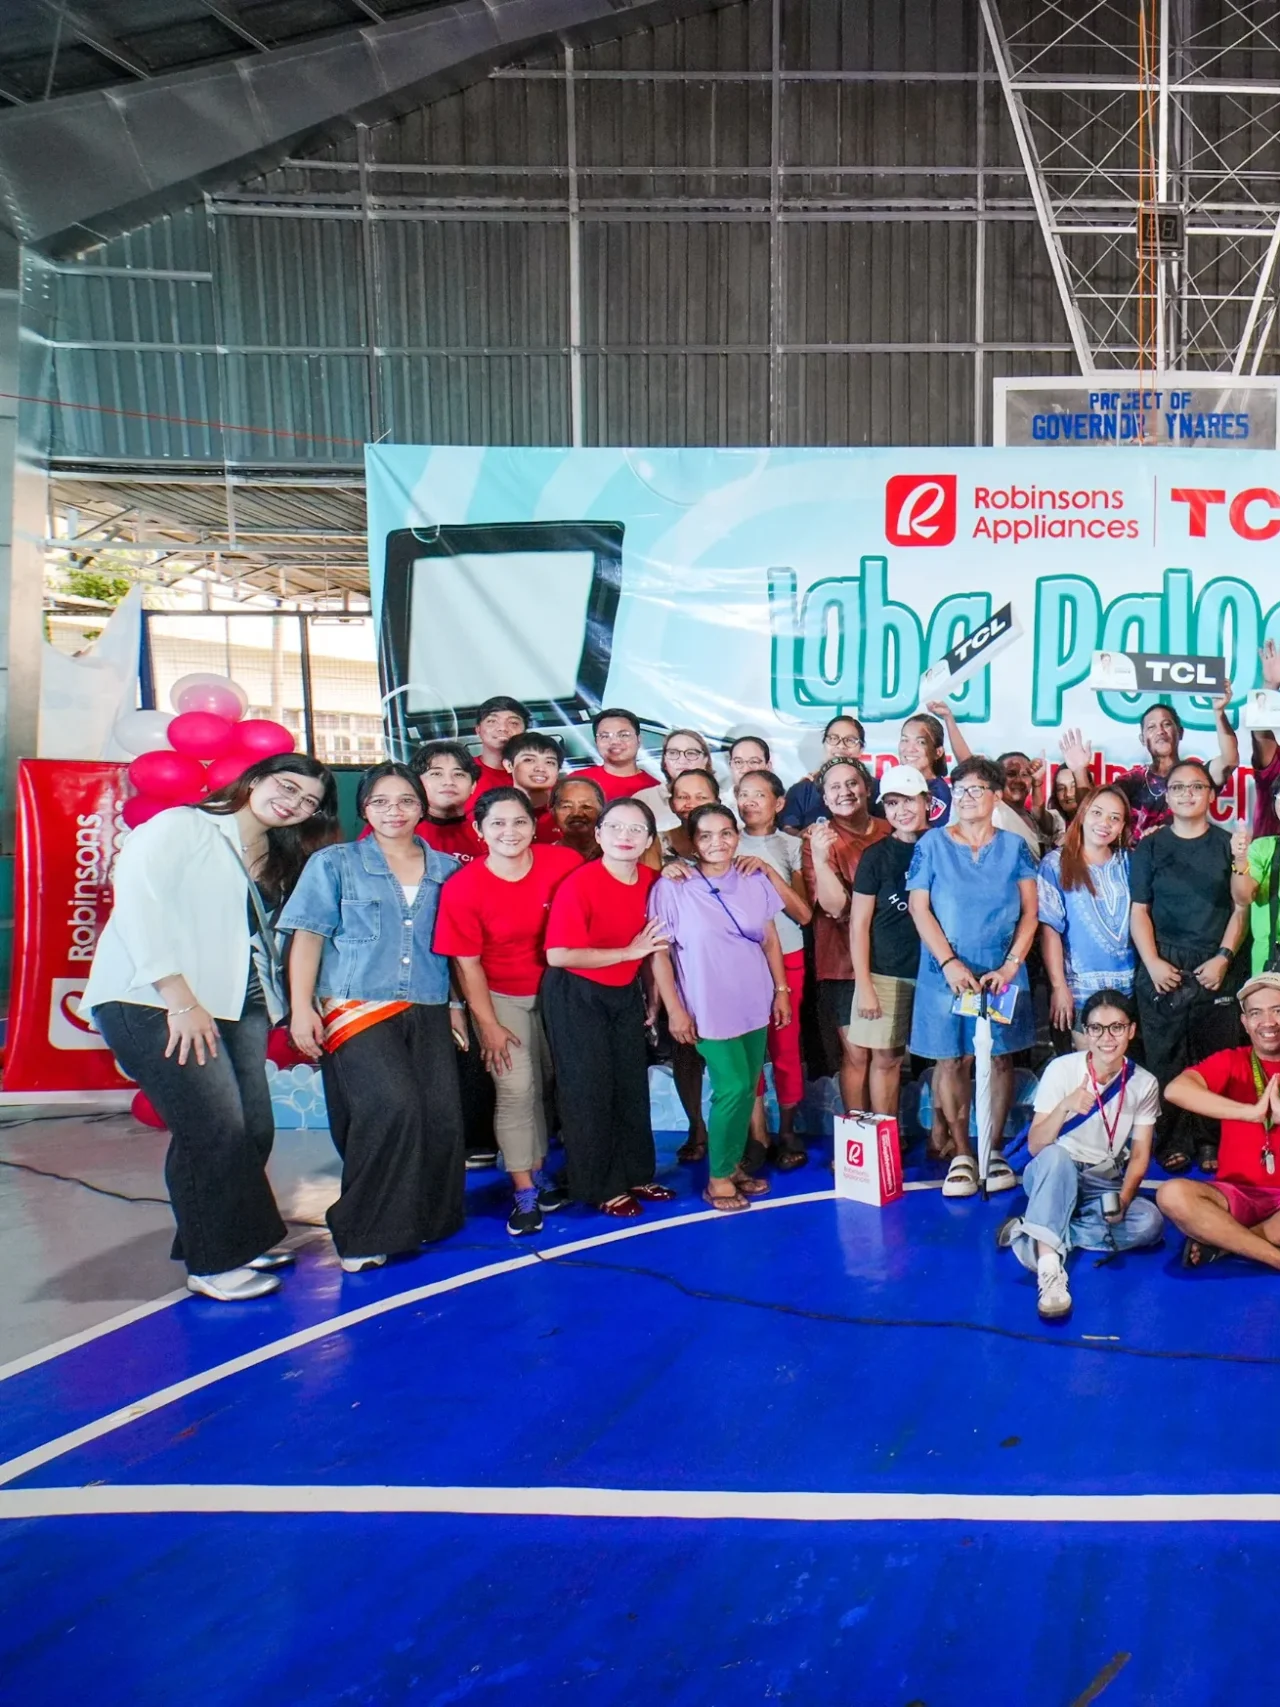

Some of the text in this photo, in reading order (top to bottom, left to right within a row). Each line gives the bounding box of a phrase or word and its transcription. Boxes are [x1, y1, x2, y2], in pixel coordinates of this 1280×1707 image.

[1089, 392, 1191, 410] PROJECT OF
[1032, 413, 1249, 440] GOVERNOR YNARES
[975, 485, 1124, 510] Robinsons
[972, 514, 1139, 544] Appliances
[955, 618, 1006, 661] TCL
[1145, 661, 1217, 685] TCL
[66, 813, 102, 961] Robinsons
